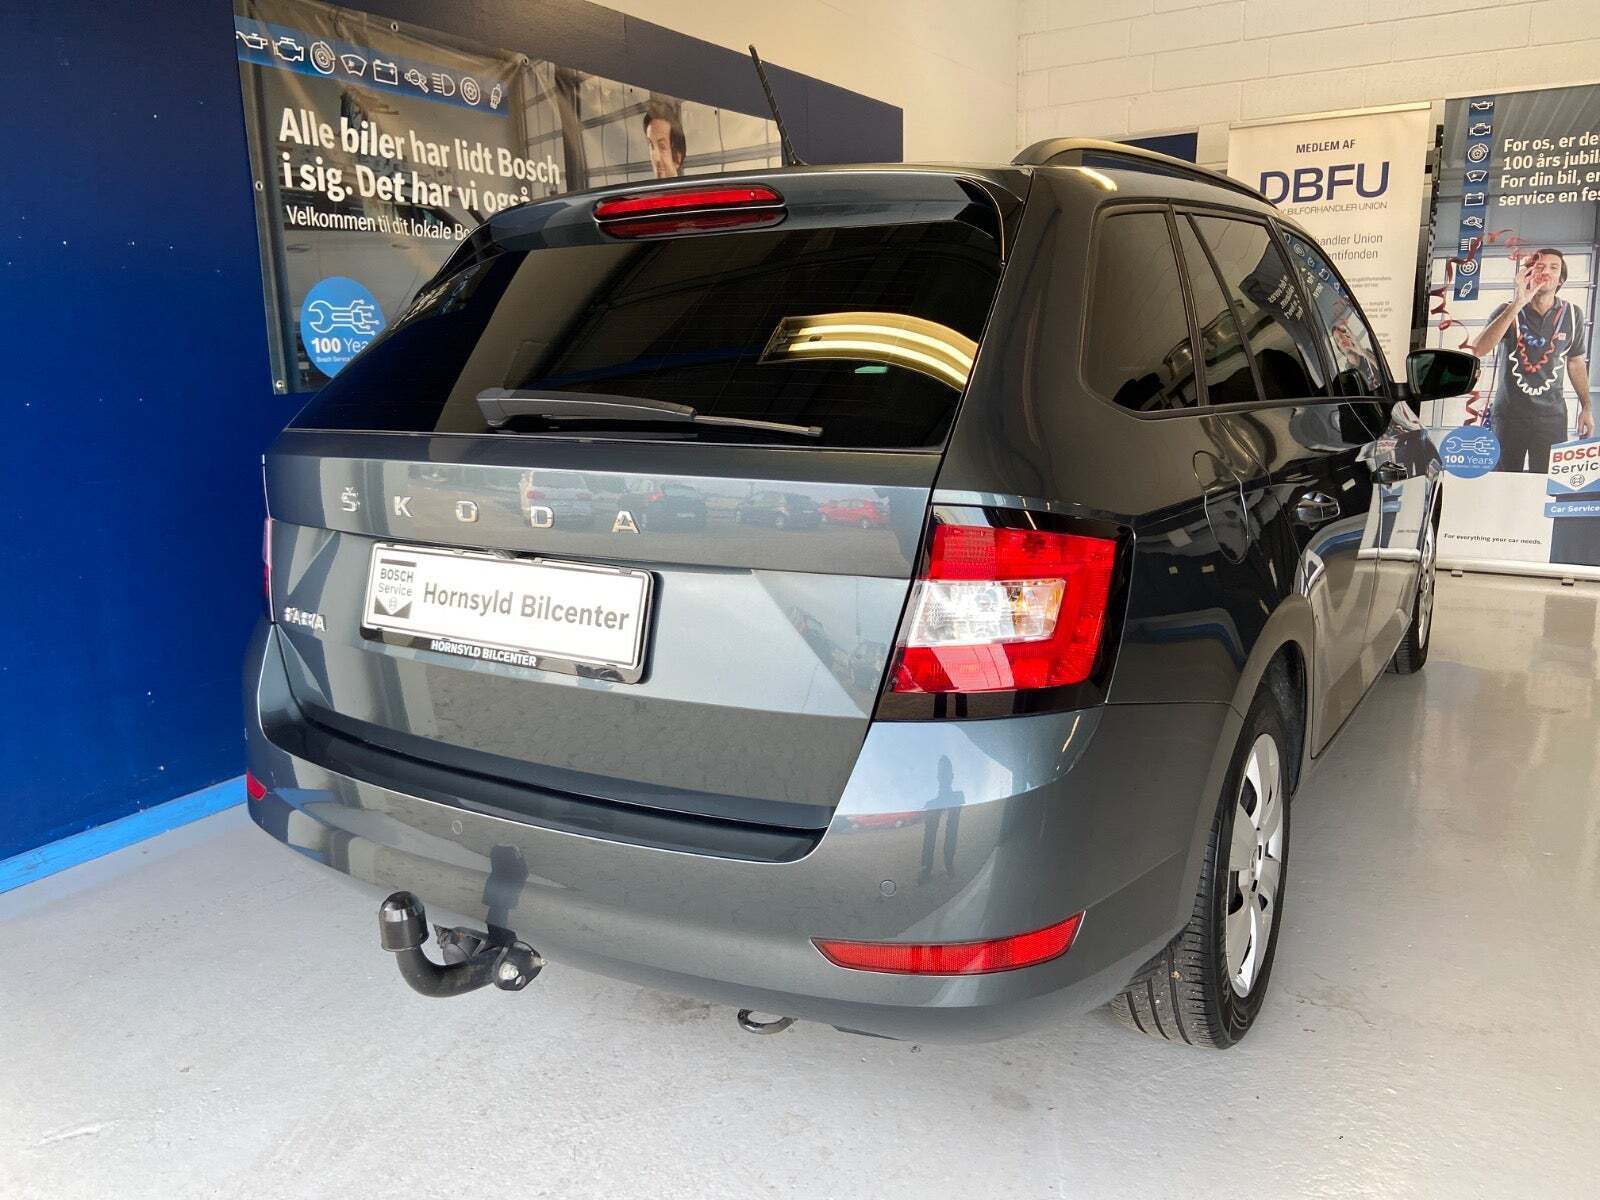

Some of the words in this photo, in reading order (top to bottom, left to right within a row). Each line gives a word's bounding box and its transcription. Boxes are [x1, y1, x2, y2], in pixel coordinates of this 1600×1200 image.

[280, 107, 335, 149] Alle
[340, 116, 405, 160] biler
[409, 129, 450, 168] har
[454, 138, 494, 175] lidt
[497, 147, 560, 185] Bosch
[1296, 140, 1340, 154] MEDLEM
[1342, 139, 1356, 149] AF
[1504, 138, 1529, 152] For
[1532, 138, 1554, 151] os,
[1559, 136, 1576, 148] er
[1579, 131, 1600, 146] de
[1503, 155, 1533, 170] 100
[1536, 152, 1561, 168] års
[1563, 149, 1600, 169] jubil
[282, 152, 293, 188] i
[300, 156, 353, 202] sig.
[355, 164, 405, 203] Det
[411, 171, 452, 207] har
[457, 180, 479, 211] vi
[1260, 161, 1390, 205] DBFU
[1500, 174, 1526, 188] For
[1529, 171, 1553, 187] din
[1557, 169, 1581, 186] bil,
[1499, 190, 1555, 207] service
[1559, 191, 1578, 203] en
[1287, 203, 1358, 215] BILFORHANDLER
[1360, 201, 1388, 211] UNION
[286, 205, 376, 232] Velkommen
[378, 215, 391, 233] til
[392, 216, 410, 237] dit
[411, 218, 451, 240] lokale
[1353, 233, 1383, 245] Union
[311, 337, 341, 354] 100
[1444, 455, 1465, 464] 100
[1467, 455, 1494, 465] Years
[1552, 445, 1600, 463] BOSC
[1551, 460, 1600, 475] Servic
[1568, 504, 1600, 512] Service
[1456, 534, 1491, 543] everything
[380, 568, 414, 583] BOSCH
[378, 582, 413, 597] Service
[423, 582, 514, 617] Hornsyld
[520, 593, 630, 630] Bilcenter
[430, 639, 481, 658] HORNSYLD
[482, 648, 537, 667] BILCENTER
